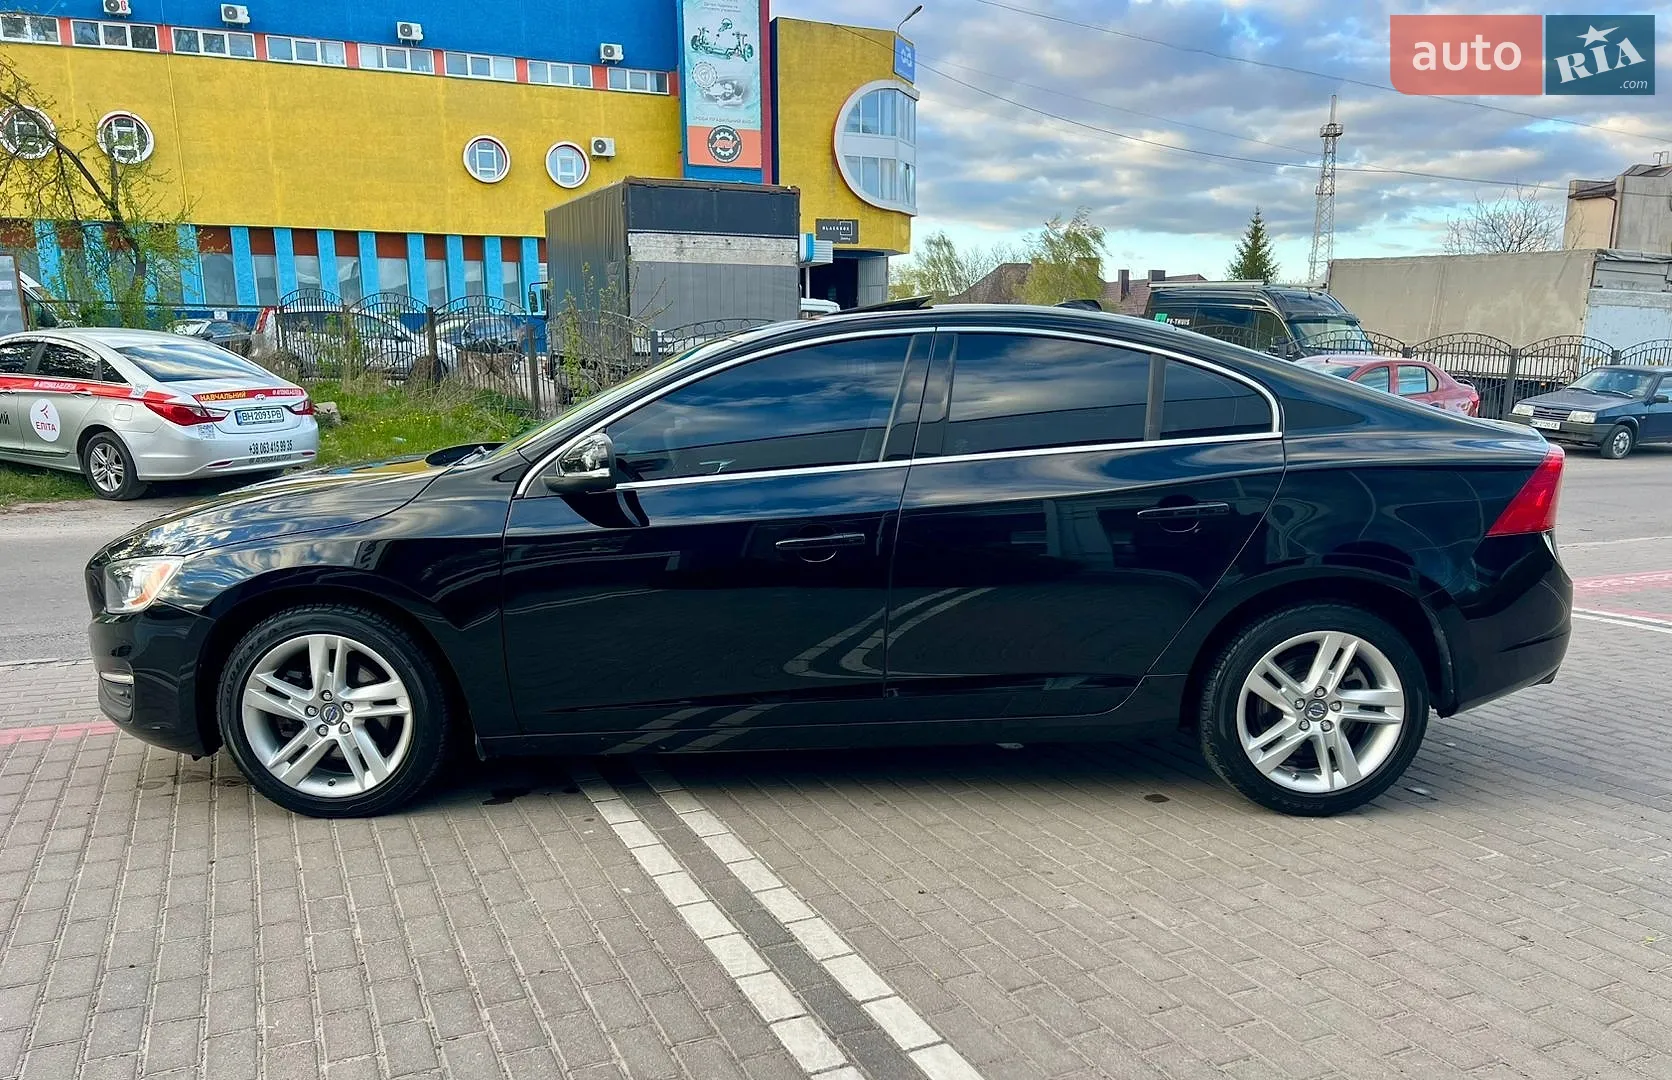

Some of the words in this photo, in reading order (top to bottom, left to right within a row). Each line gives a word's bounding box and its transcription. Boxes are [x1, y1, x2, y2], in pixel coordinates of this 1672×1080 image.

[200, 391, 246, 401] НАВЧАЛЬНИЙ
[249, 443, 259, 454] +38
[260, 442, 269, 453] 063
[271, 441, 279, 452] 415
[280, 440, 286, 451] 99
[287, 440, 293, 451] 35
